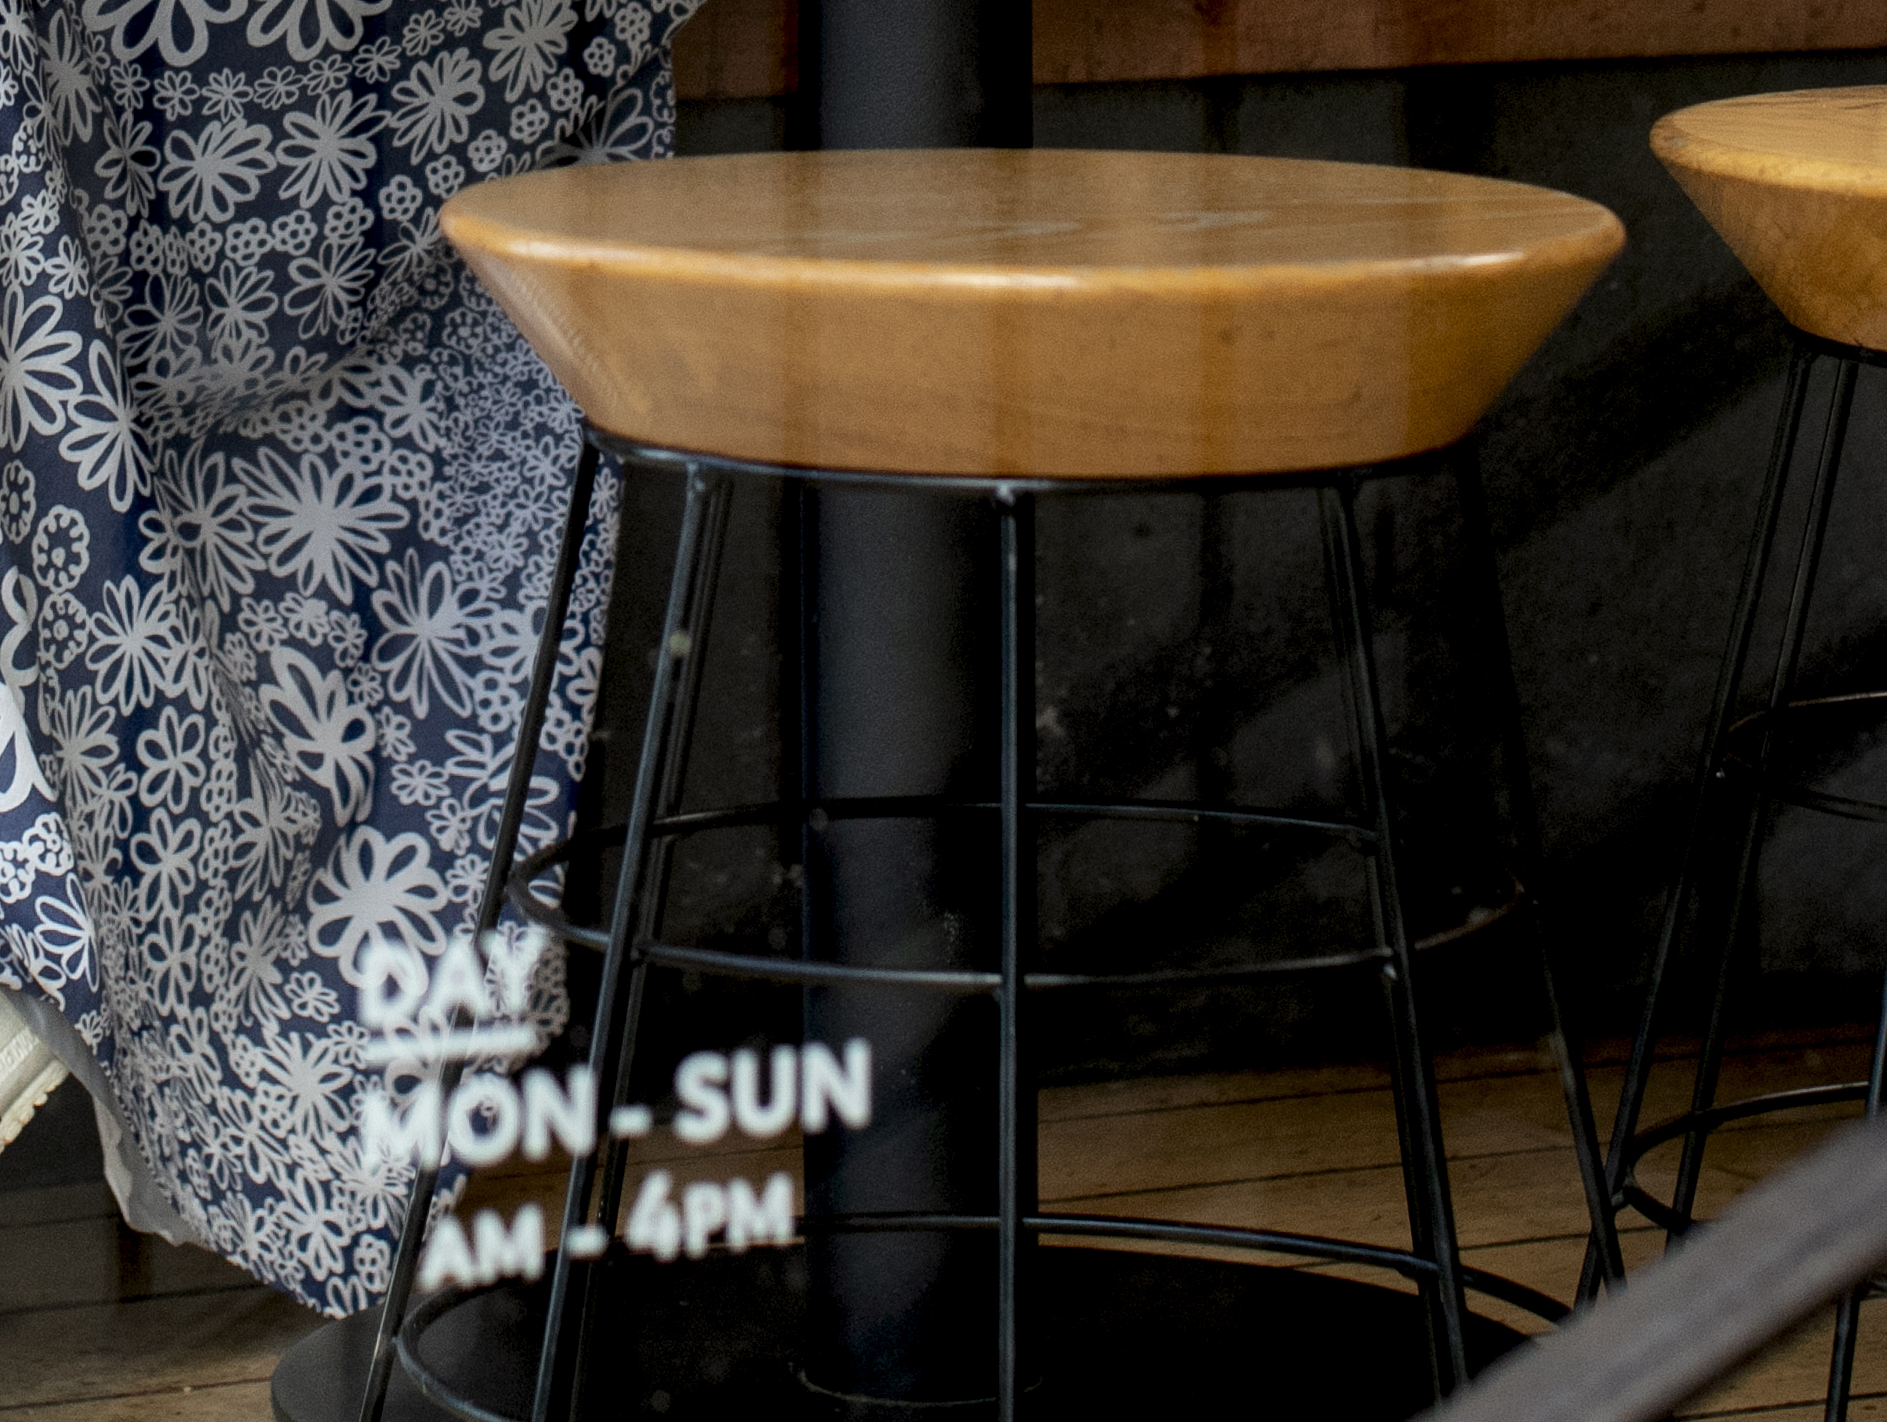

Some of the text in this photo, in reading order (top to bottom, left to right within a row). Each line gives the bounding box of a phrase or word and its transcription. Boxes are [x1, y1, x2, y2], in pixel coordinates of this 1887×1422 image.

[357, 925, 552, 1027] DAY
[360, 1061, 599, 1175] MON
[672, 1036, 873, 1144] SUN
[417, 1201, 547, 1292] AM
[624, 1169, 796, 1264] 4PM
